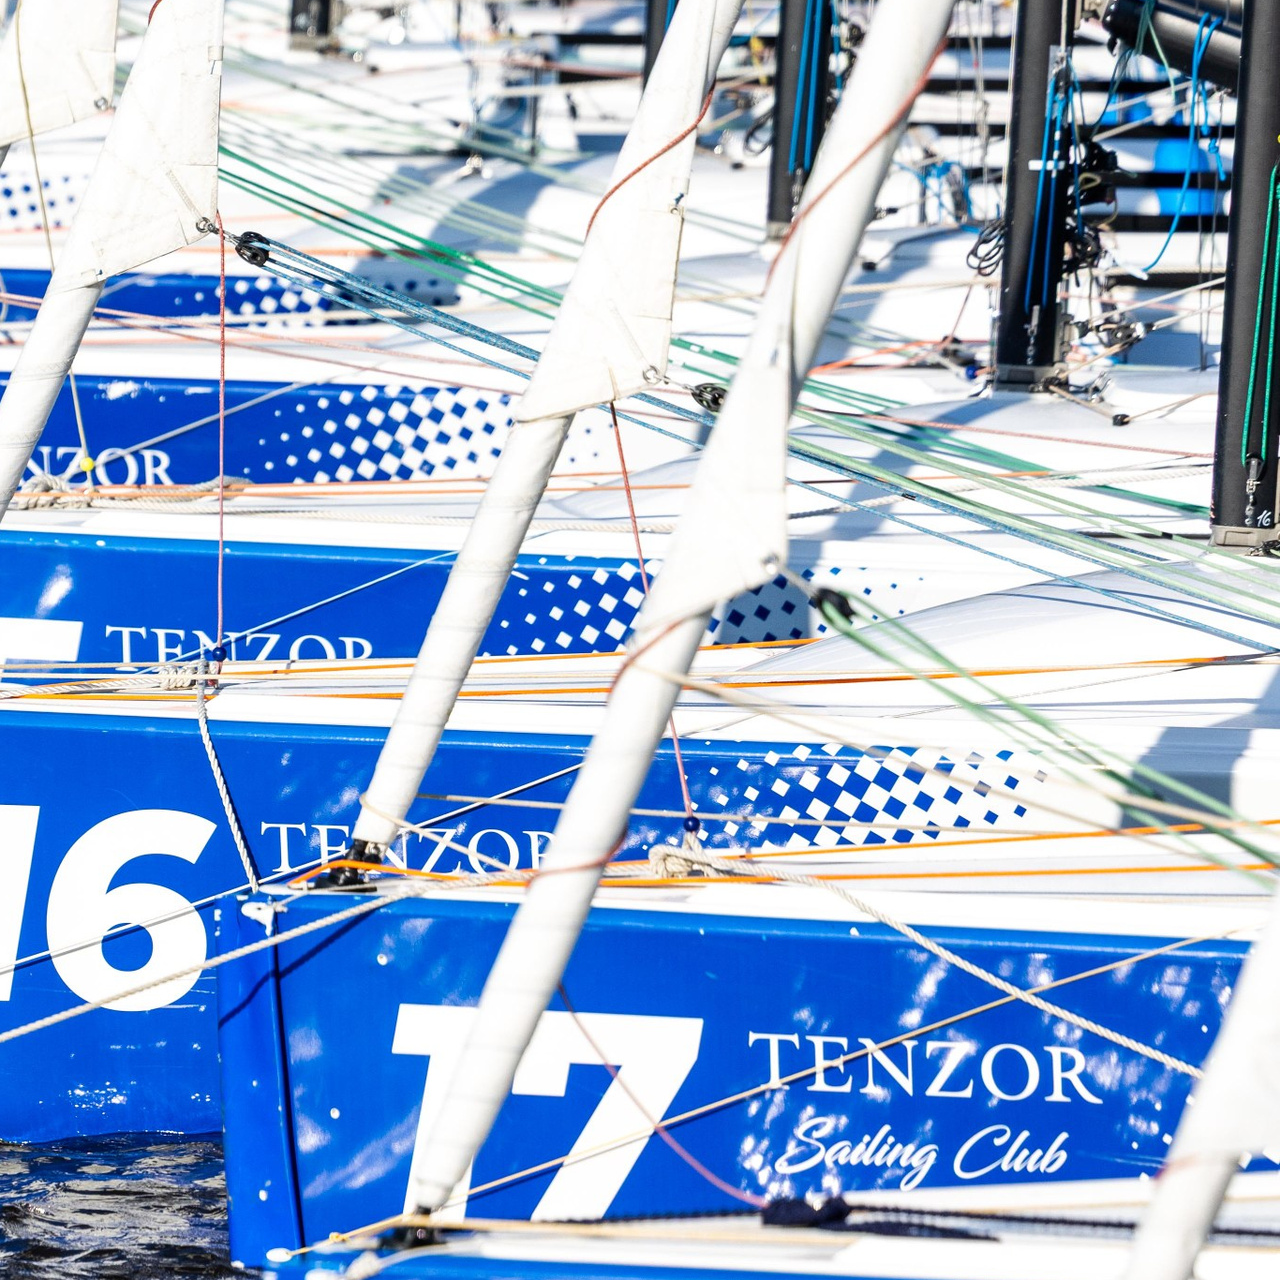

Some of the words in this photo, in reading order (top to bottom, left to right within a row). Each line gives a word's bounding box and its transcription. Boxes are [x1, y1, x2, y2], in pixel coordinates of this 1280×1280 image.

[1257, 509, 1272, 527] 16
[748, 1030, 1104, 1105] TENZOR
[391, 1003, 705, 1223] 17
[774, 1116, 939, 1192] Sailing
[953, 1124, 1070, 1180] Club
